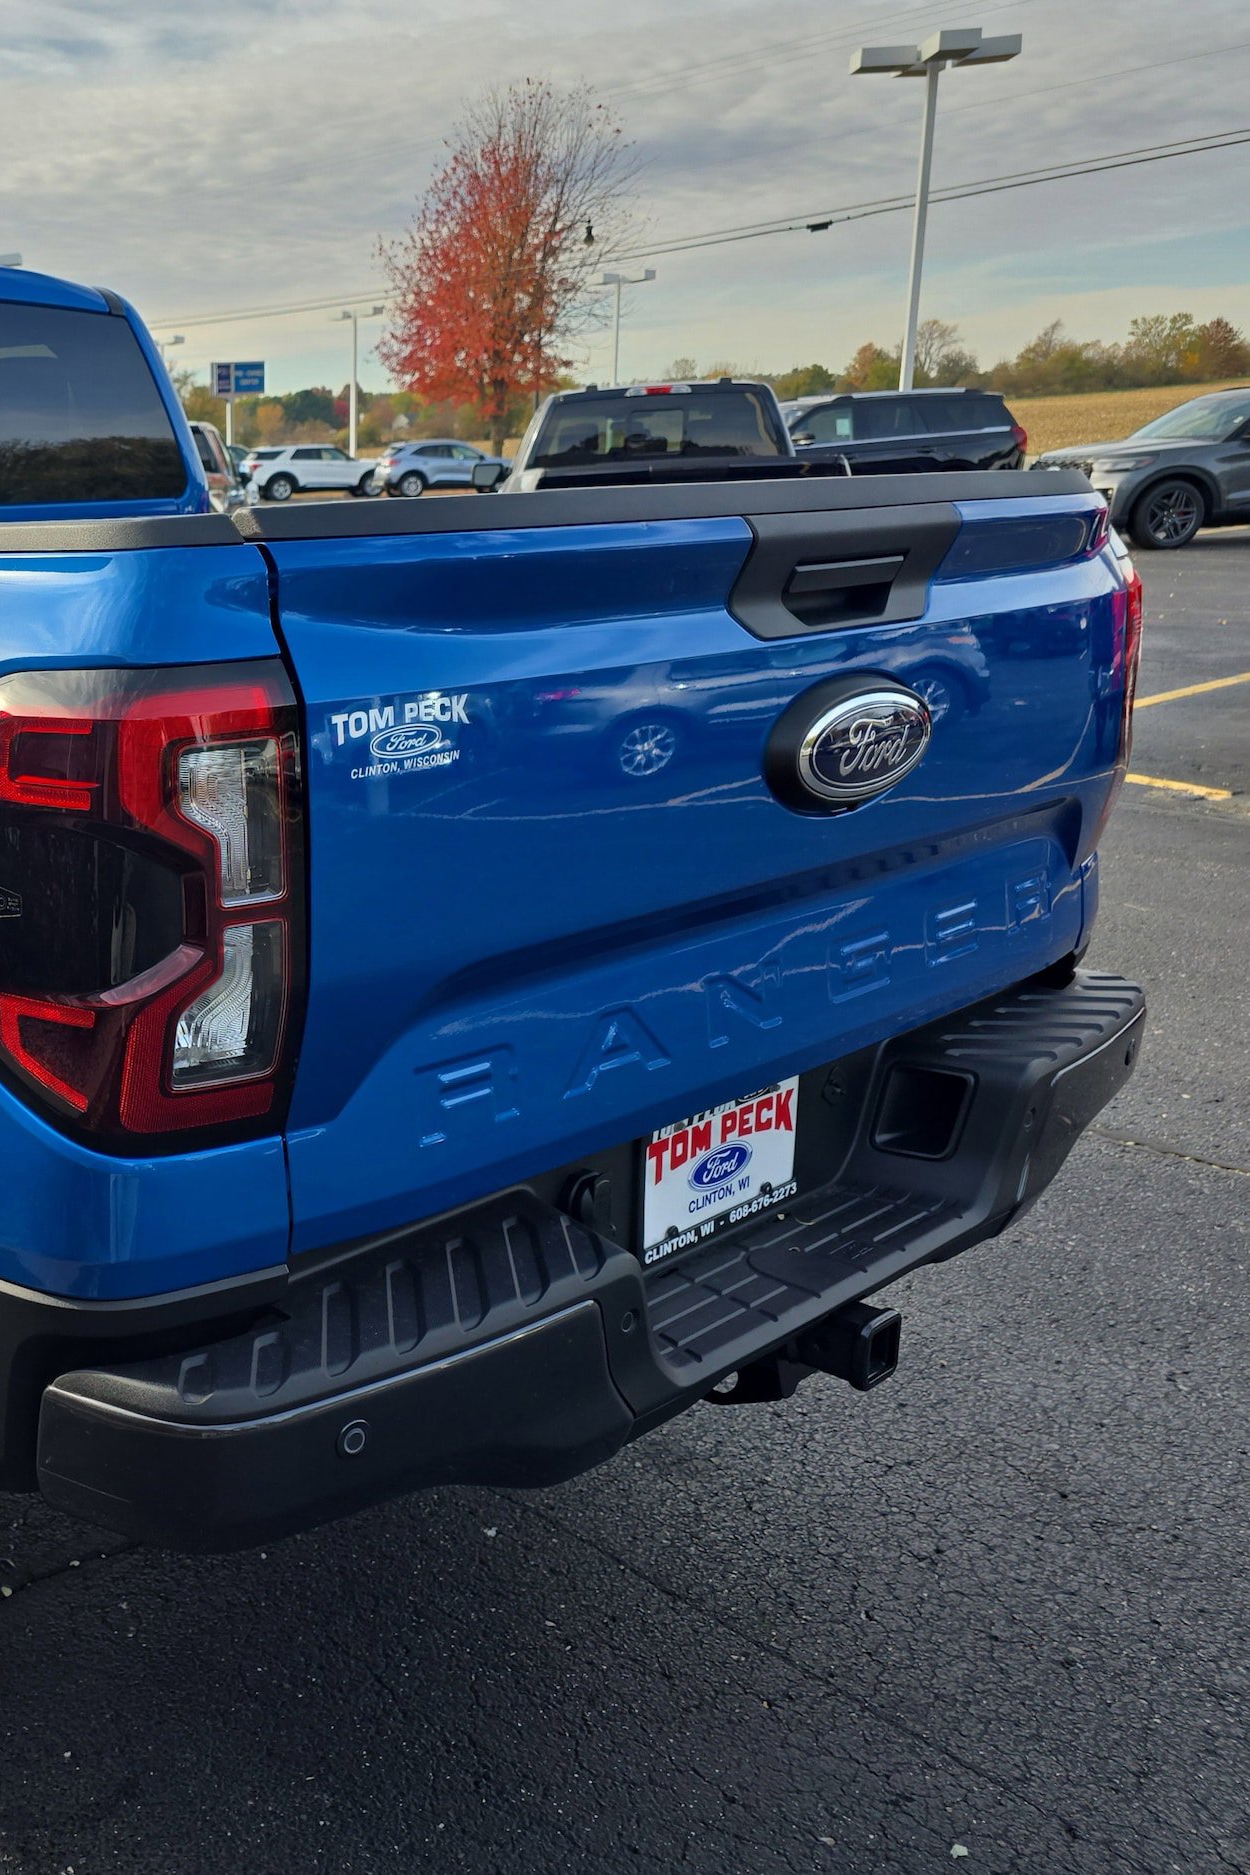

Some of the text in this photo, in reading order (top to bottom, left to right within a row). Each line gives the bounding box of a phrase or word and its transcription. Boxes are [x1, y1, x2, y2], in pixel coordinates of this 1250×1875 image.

[331, 693, 470, 746] TOM PECK
[385, 730, 428, 752] Ford
[839, 715, 910, 777] Ford
[350, 749, 461, 780] CLINTON, WISCONSIN
[413, 863, 1051, 1147] RANGER
[647, 1119, 713, 1186] TOM
[720, 1088, 795, 1144] PECK
[702, 1149, 739, 1184] Ford
[688, 1175, 751, 1214] CLINTON, WI
[644, 1228, 699, 1265] CLINTON,
[700, 1220, 715, 1238] WI
[729, 1181, 798, 1224] 608-676-2273
